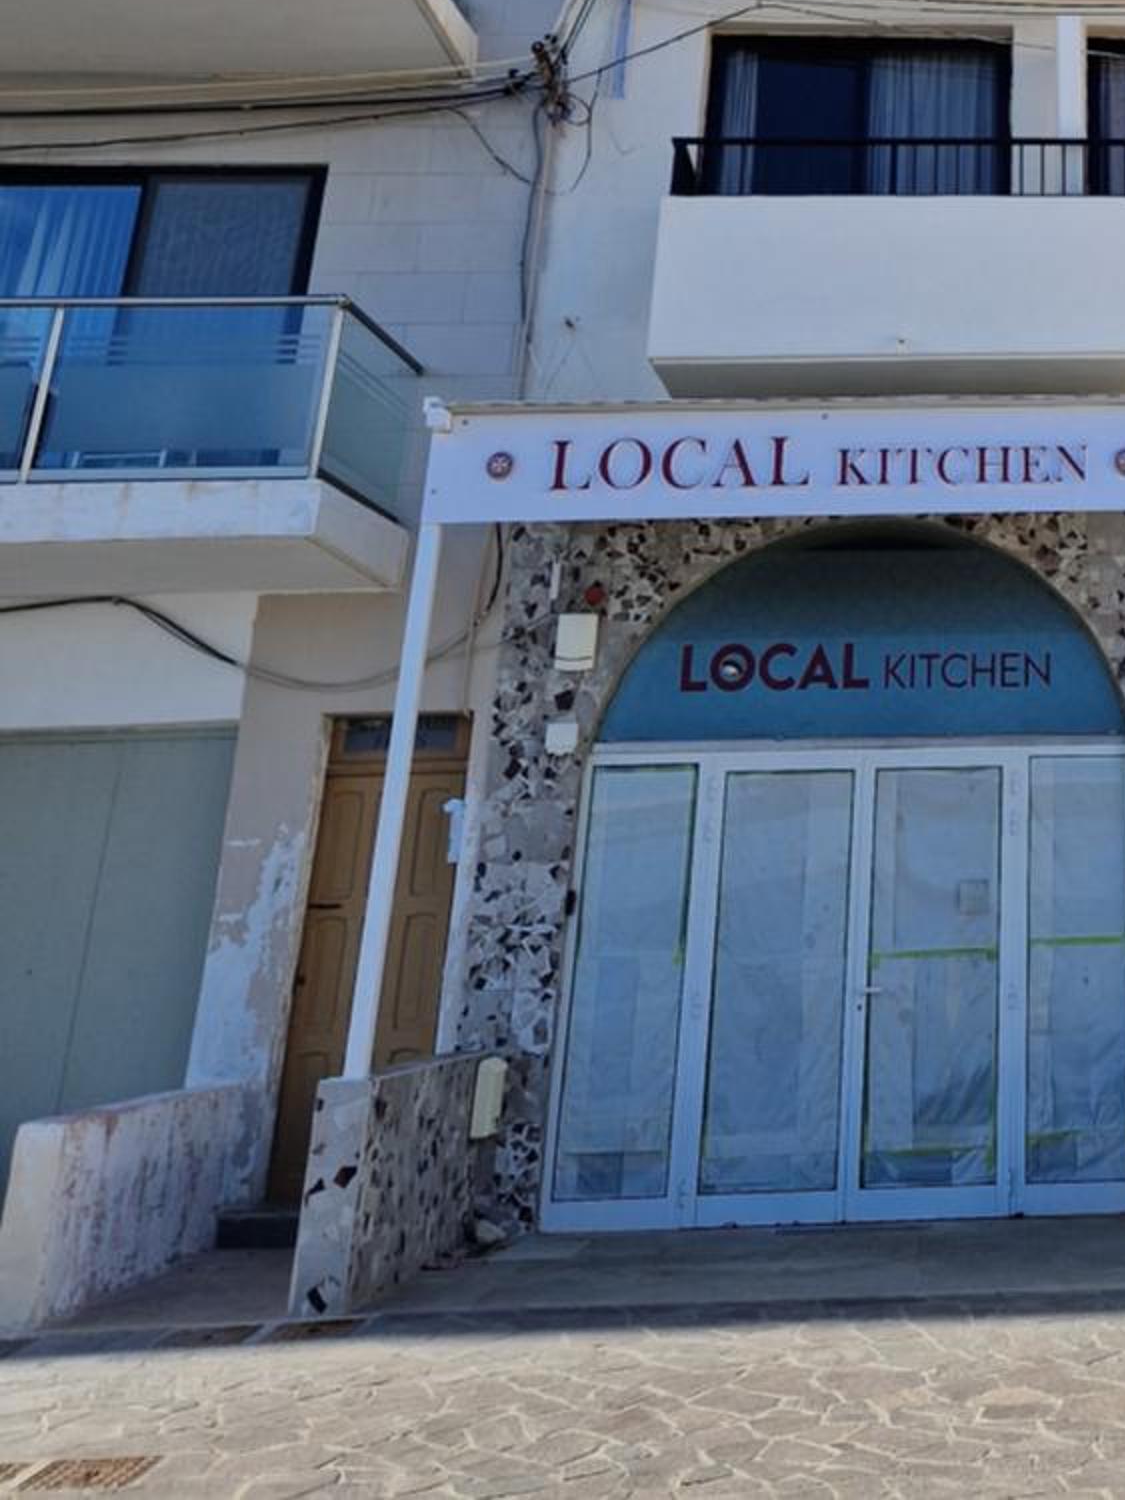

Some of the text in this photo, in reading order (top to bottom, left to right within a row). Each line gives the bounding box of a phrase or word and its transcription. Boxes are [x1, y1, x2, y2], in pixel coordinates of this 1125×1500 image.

[551, 435, 1088, 491] LOCAL KITCHEN
[680, 642, 1052, 693] LOCAL KITCHEN
